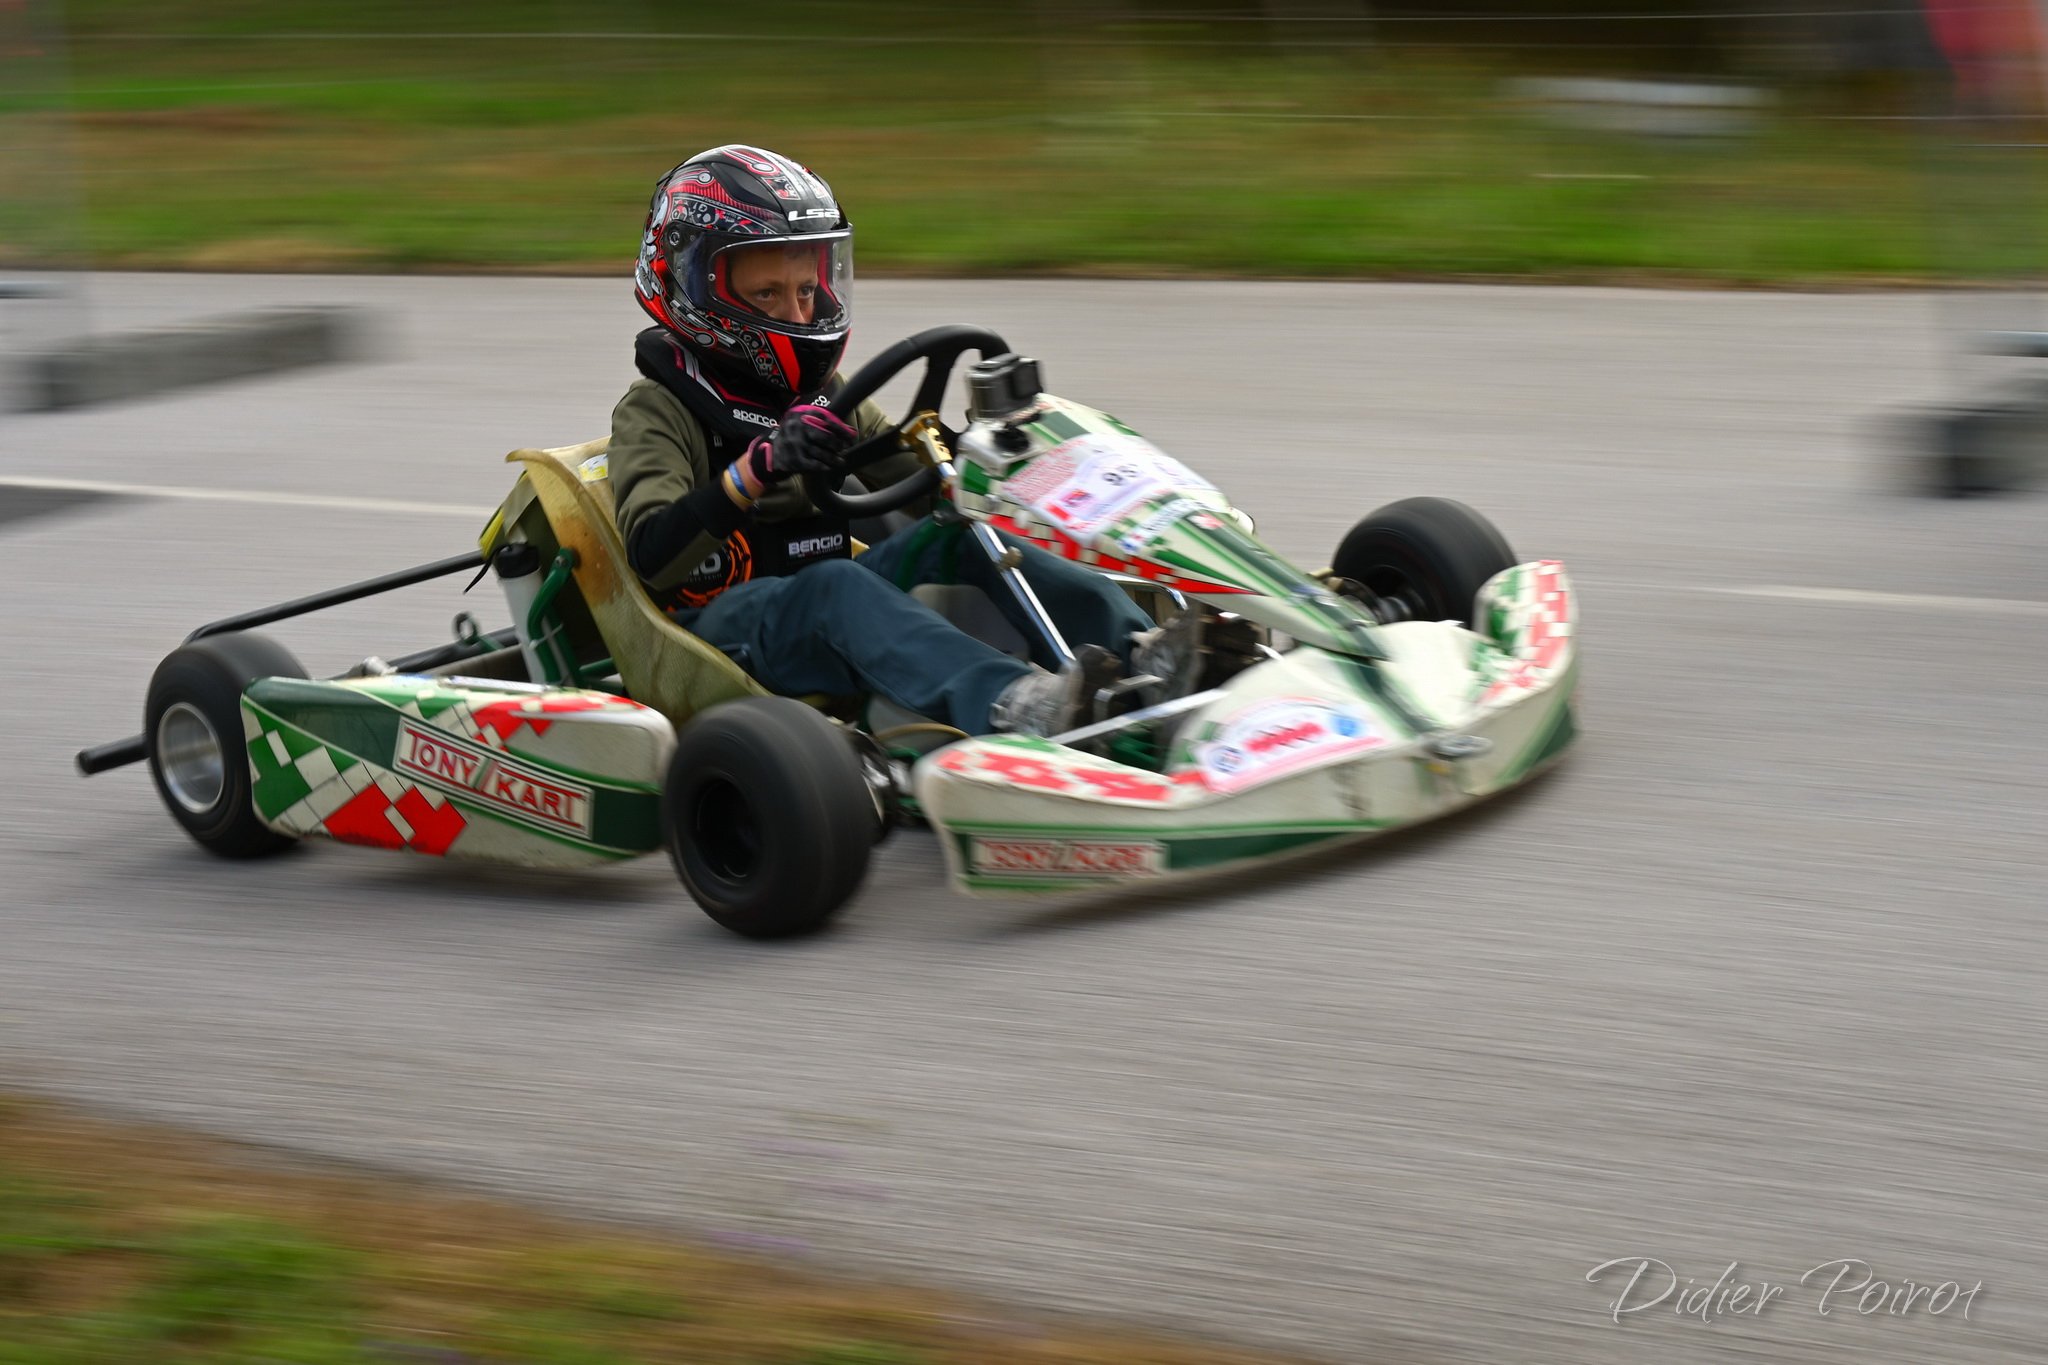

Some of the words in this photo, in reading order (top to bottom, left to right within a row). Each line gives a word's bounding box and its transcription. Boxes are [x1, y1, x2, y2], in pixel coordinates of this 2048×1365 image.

[788, 208, 840, 221] LS2
[732, 408, 778, 429] sparco
[788, 534, 844, 555] BENGIO
[403, 726, 479, 786] TONY
[497, 765, 586, 821] KART
